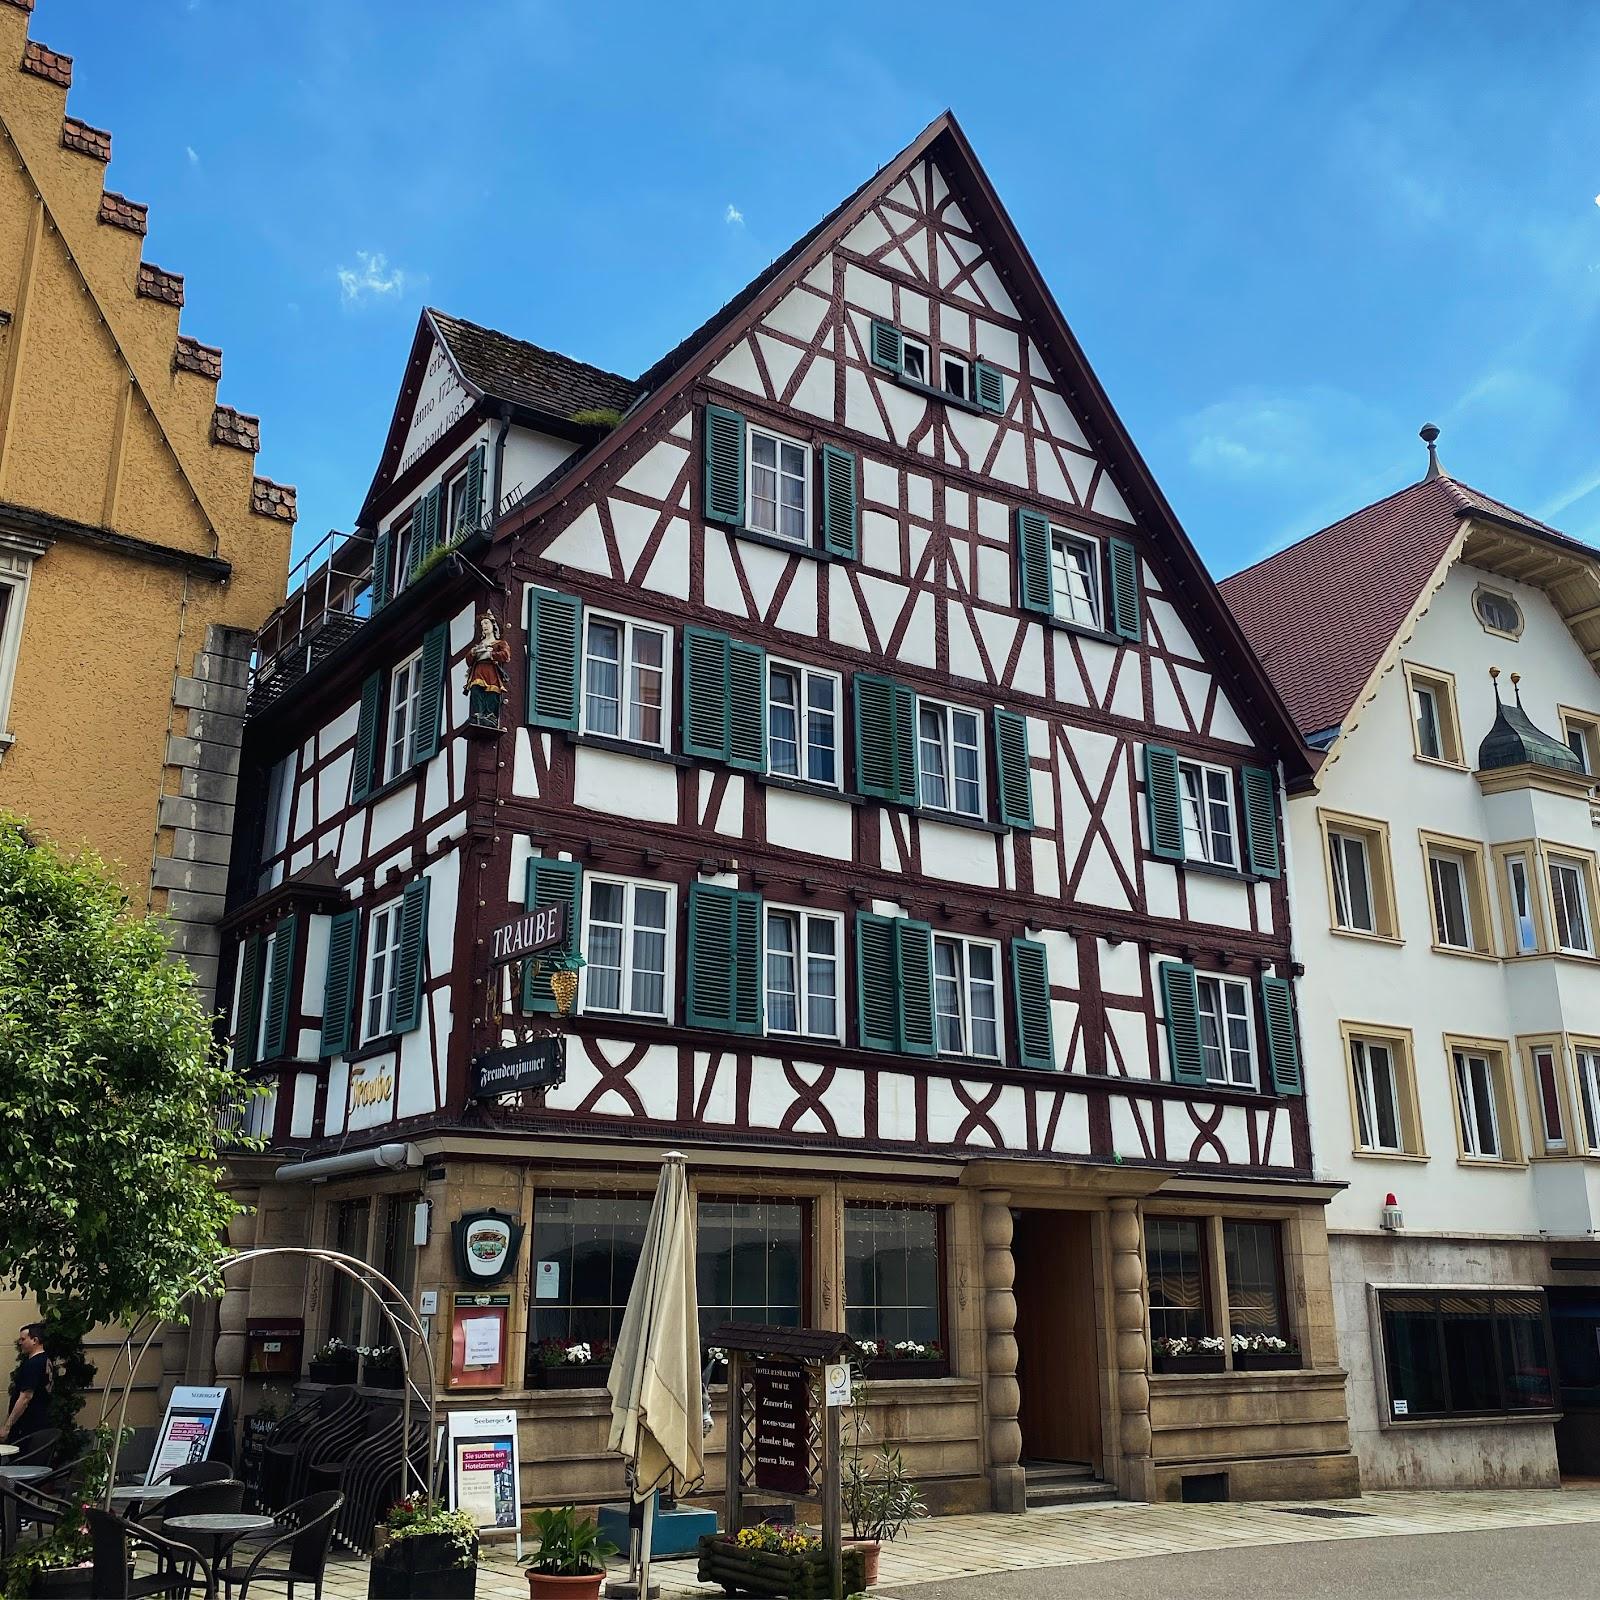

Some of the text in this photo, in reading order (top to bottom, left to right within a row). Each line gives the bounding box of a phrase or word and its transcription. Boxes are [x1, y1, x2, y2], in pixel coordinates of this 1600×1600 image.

[413, 398, 435, 428] anno
[493, 908, 557, 958] TRAUBE
[480, 1057, 546, 1087] Fremdenzimmer
[348, 1065, 393, 1115] Traube
[755, 1367, 770, 1375] HOTEL
[762, 1397, 793, 1410] Zimmer frei
[782, 1438, 795, 1449] libre
[465, 1461, 504, 1470] Hotelzimmer?
